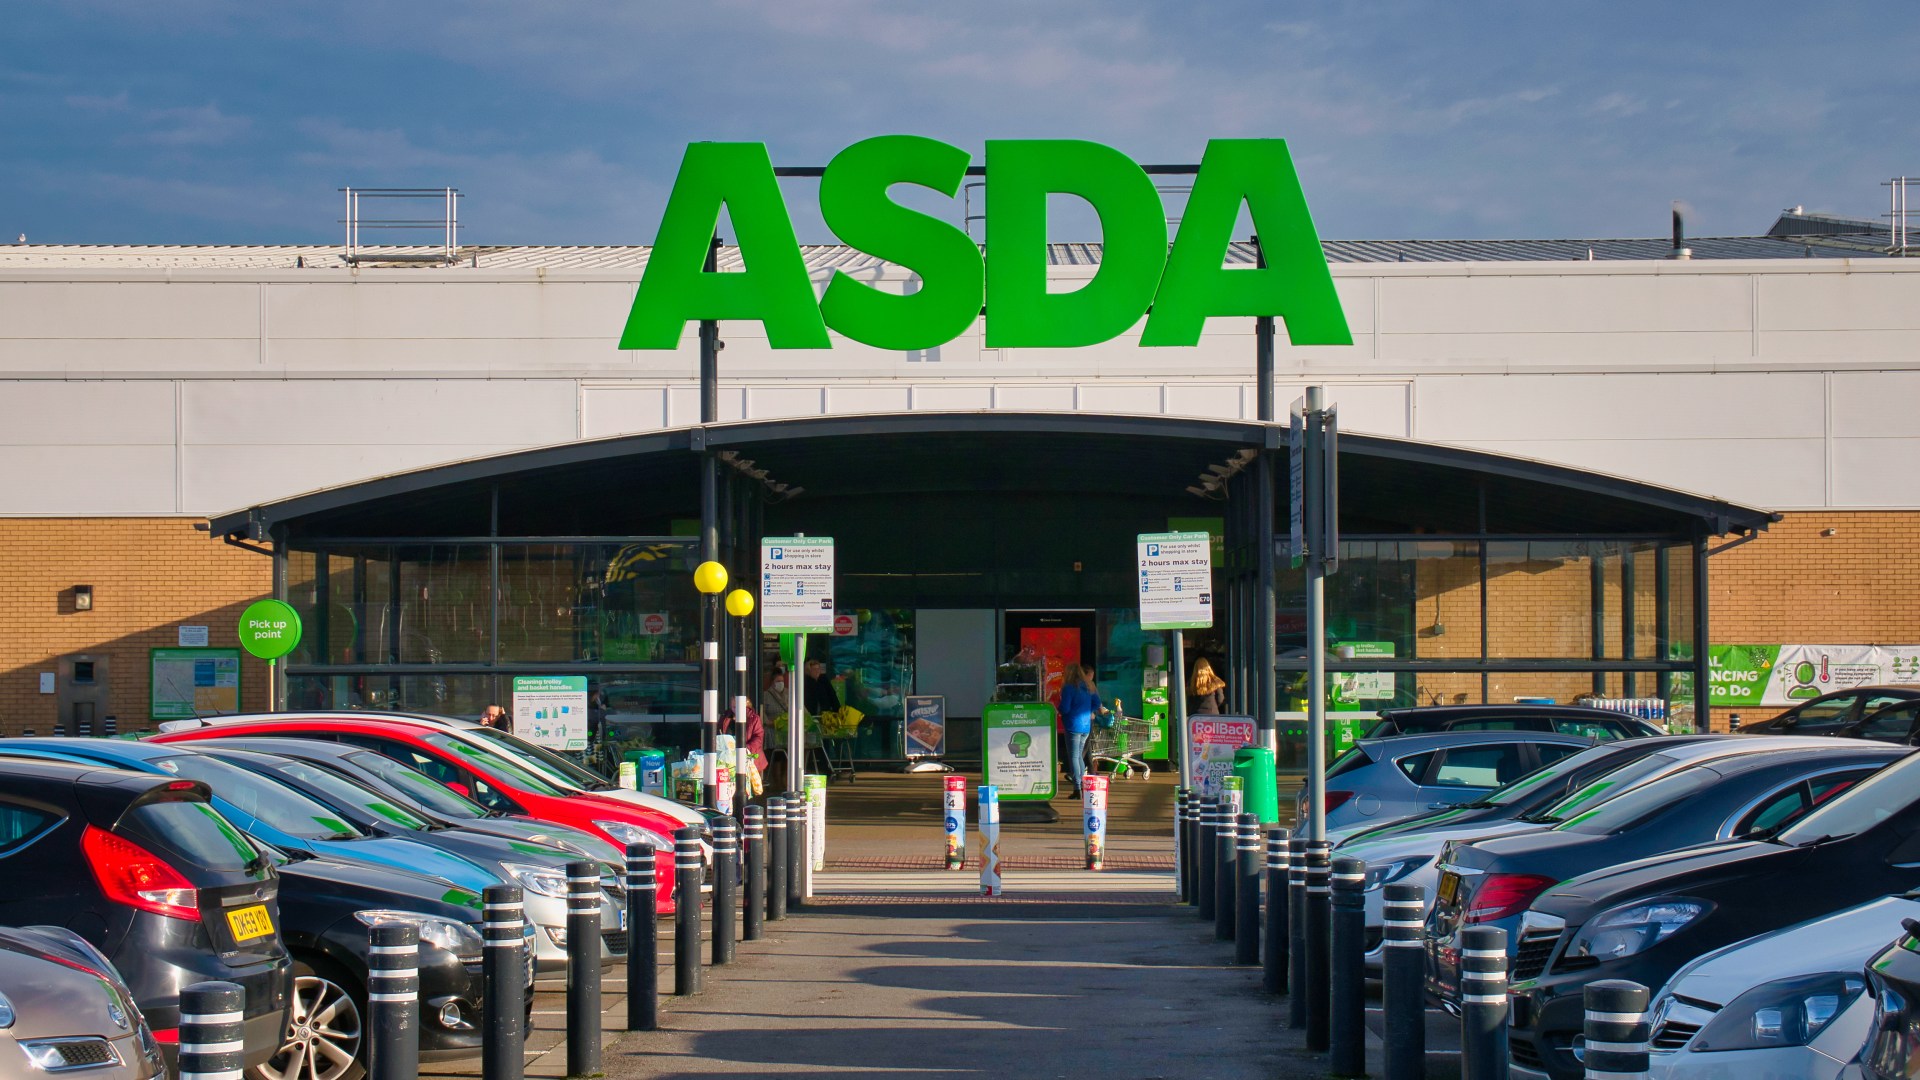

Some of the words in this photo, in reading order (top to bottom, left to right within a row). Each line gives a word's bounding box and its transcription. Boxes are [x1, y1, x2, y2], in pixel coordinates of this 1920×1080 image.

[618, 134, 1355, 351] ASDA
[249, 620, 270, 629] Pick
[273, 621, 287, 630] up
[254, 630, 282, 640] point
[1710, 685, 1727, 696] To
[1729, 685, 1751, 696] Do
[1195, 722, 1250, 735] RollBack
[1209, 762, 1234, 770] ASDA
[648, 771, 658, 783] £1
[233, 912, 258, 936] DK59
